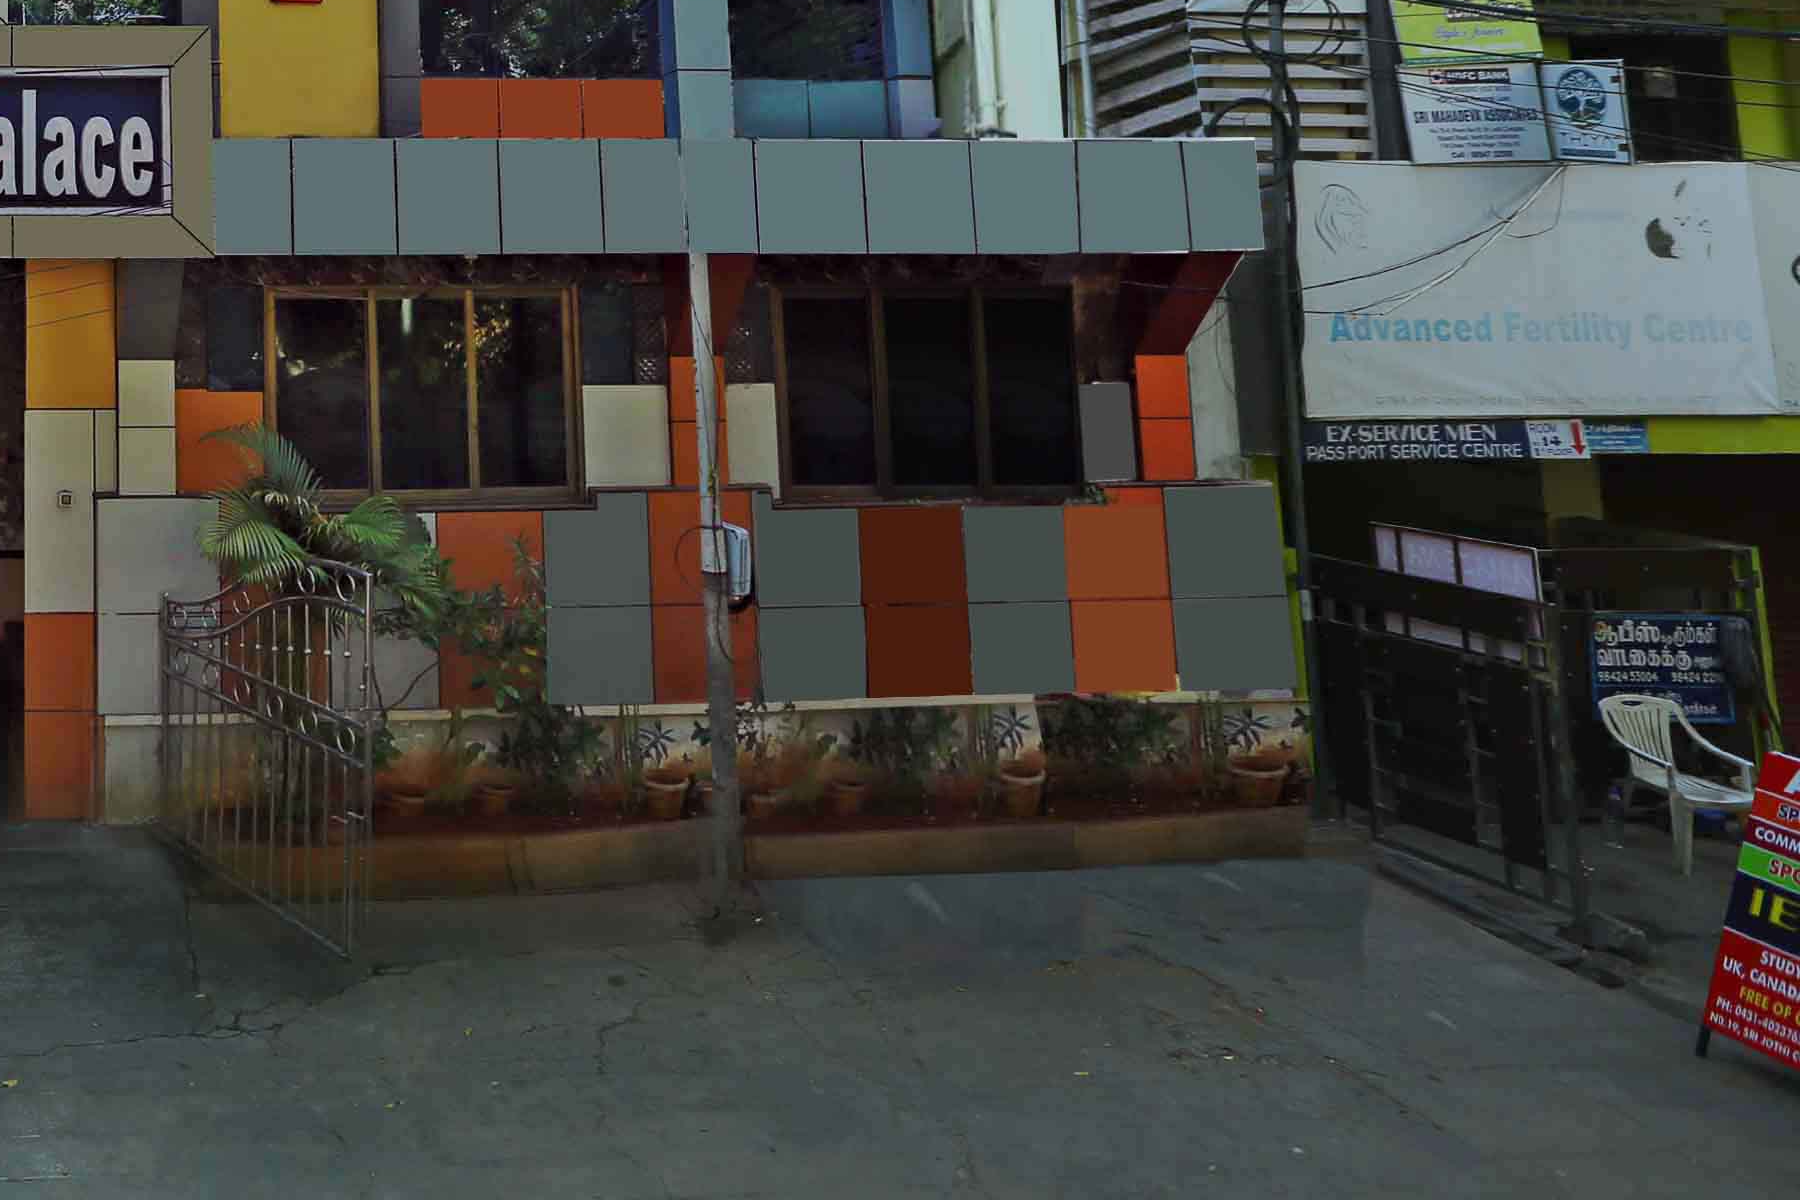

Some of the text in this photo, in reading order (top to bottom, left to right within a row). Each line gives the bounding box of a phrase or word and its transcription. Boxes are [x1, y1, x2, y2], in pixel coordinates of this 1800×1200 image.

[1329, 310, 1753, 350] Advanced Fertility Centre
[1445, 423, 1497, 441] MEN
[1391, 443, 1459, 459] SERVICE
[1462, 443, 1525, 458] CENTRE
[1739, 985, 1792, 1018] FREE OF
